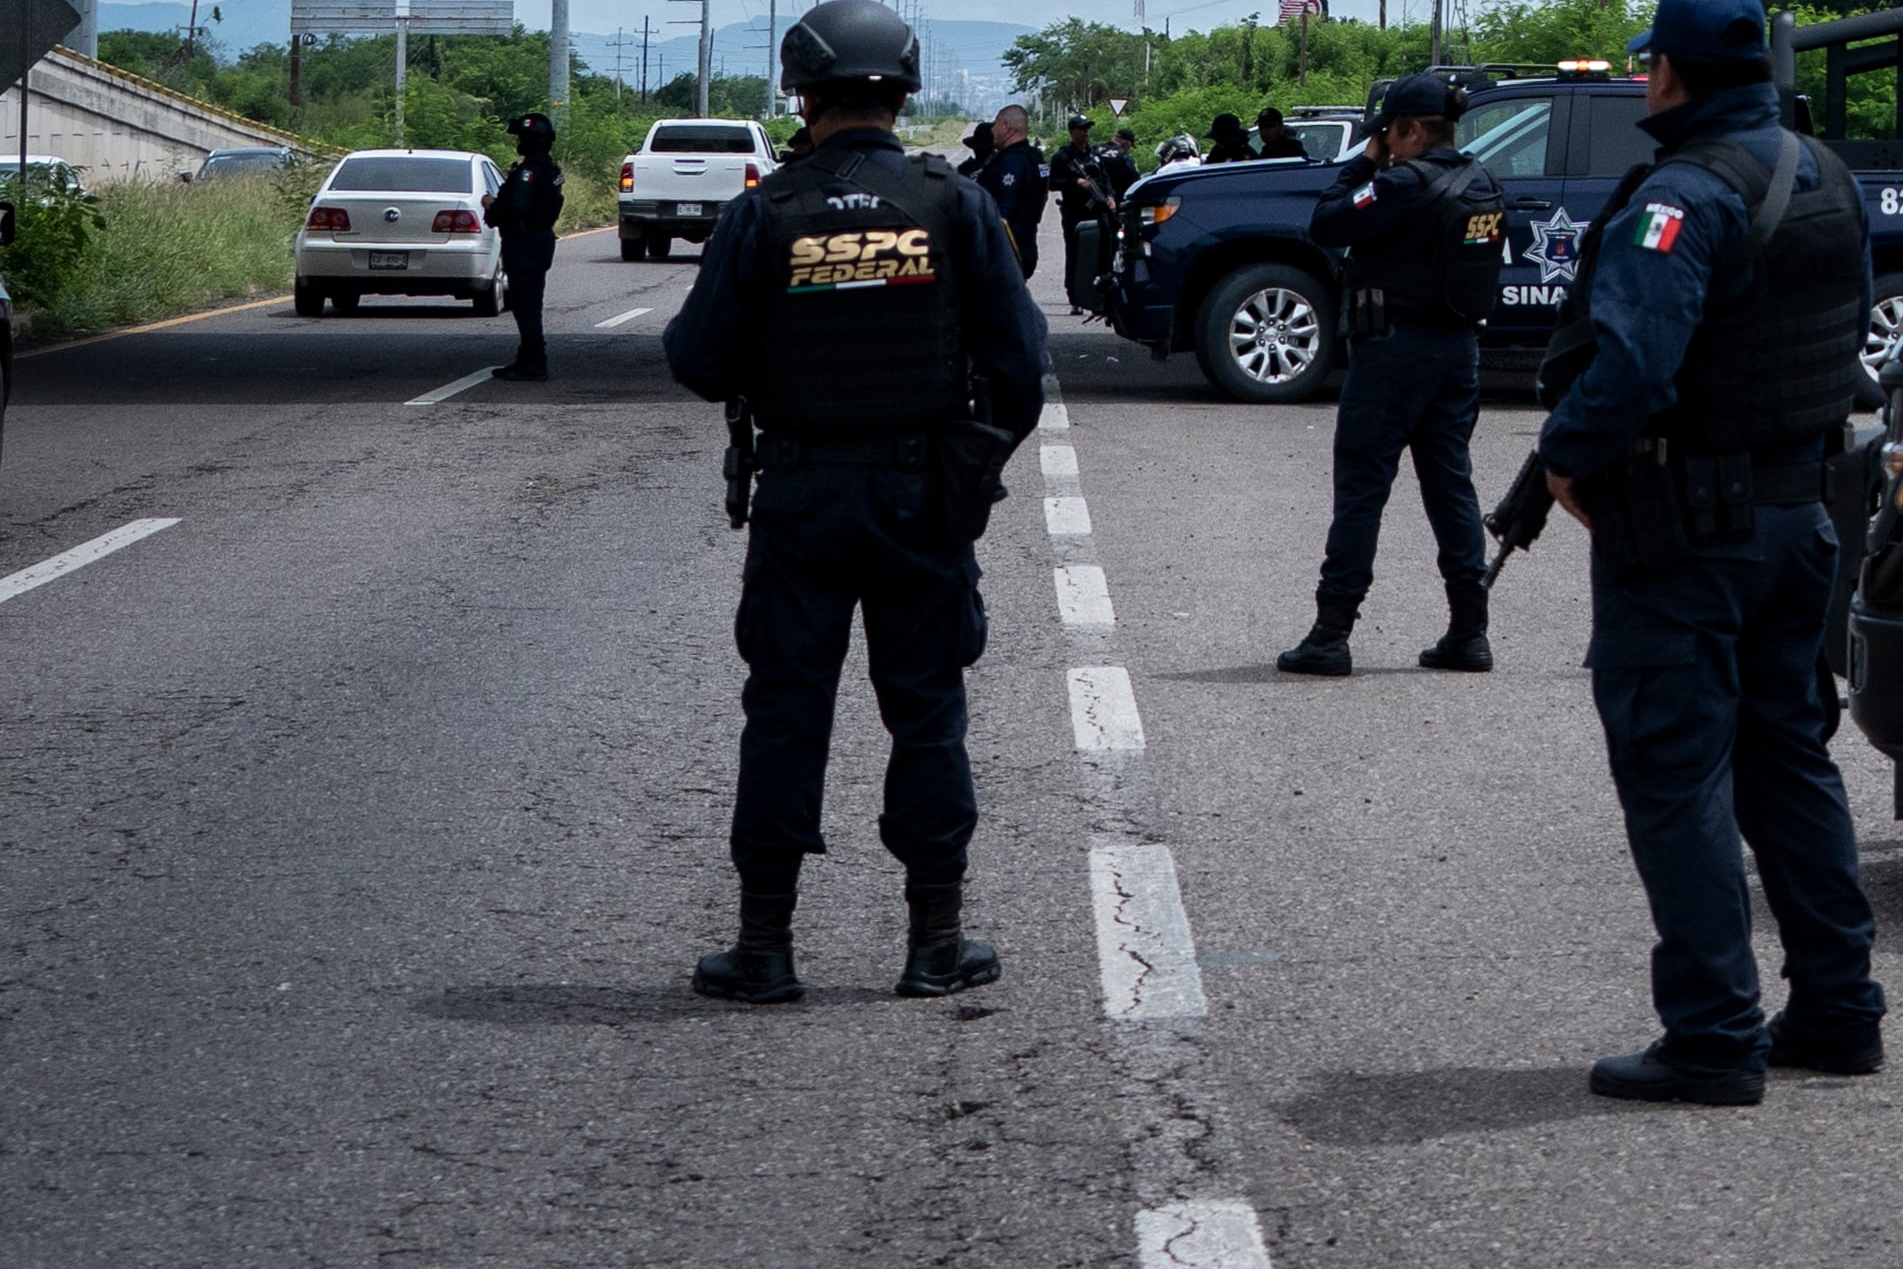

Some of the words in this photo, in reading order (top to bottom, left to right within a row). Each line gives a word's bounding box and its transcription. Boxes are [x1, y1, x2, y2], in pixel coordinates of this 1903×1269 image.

[789, 229, 929, 266] SSPC
[789, 256, 935, 287] FEDERAL
[1502, 285, 1567, 305] SINA
